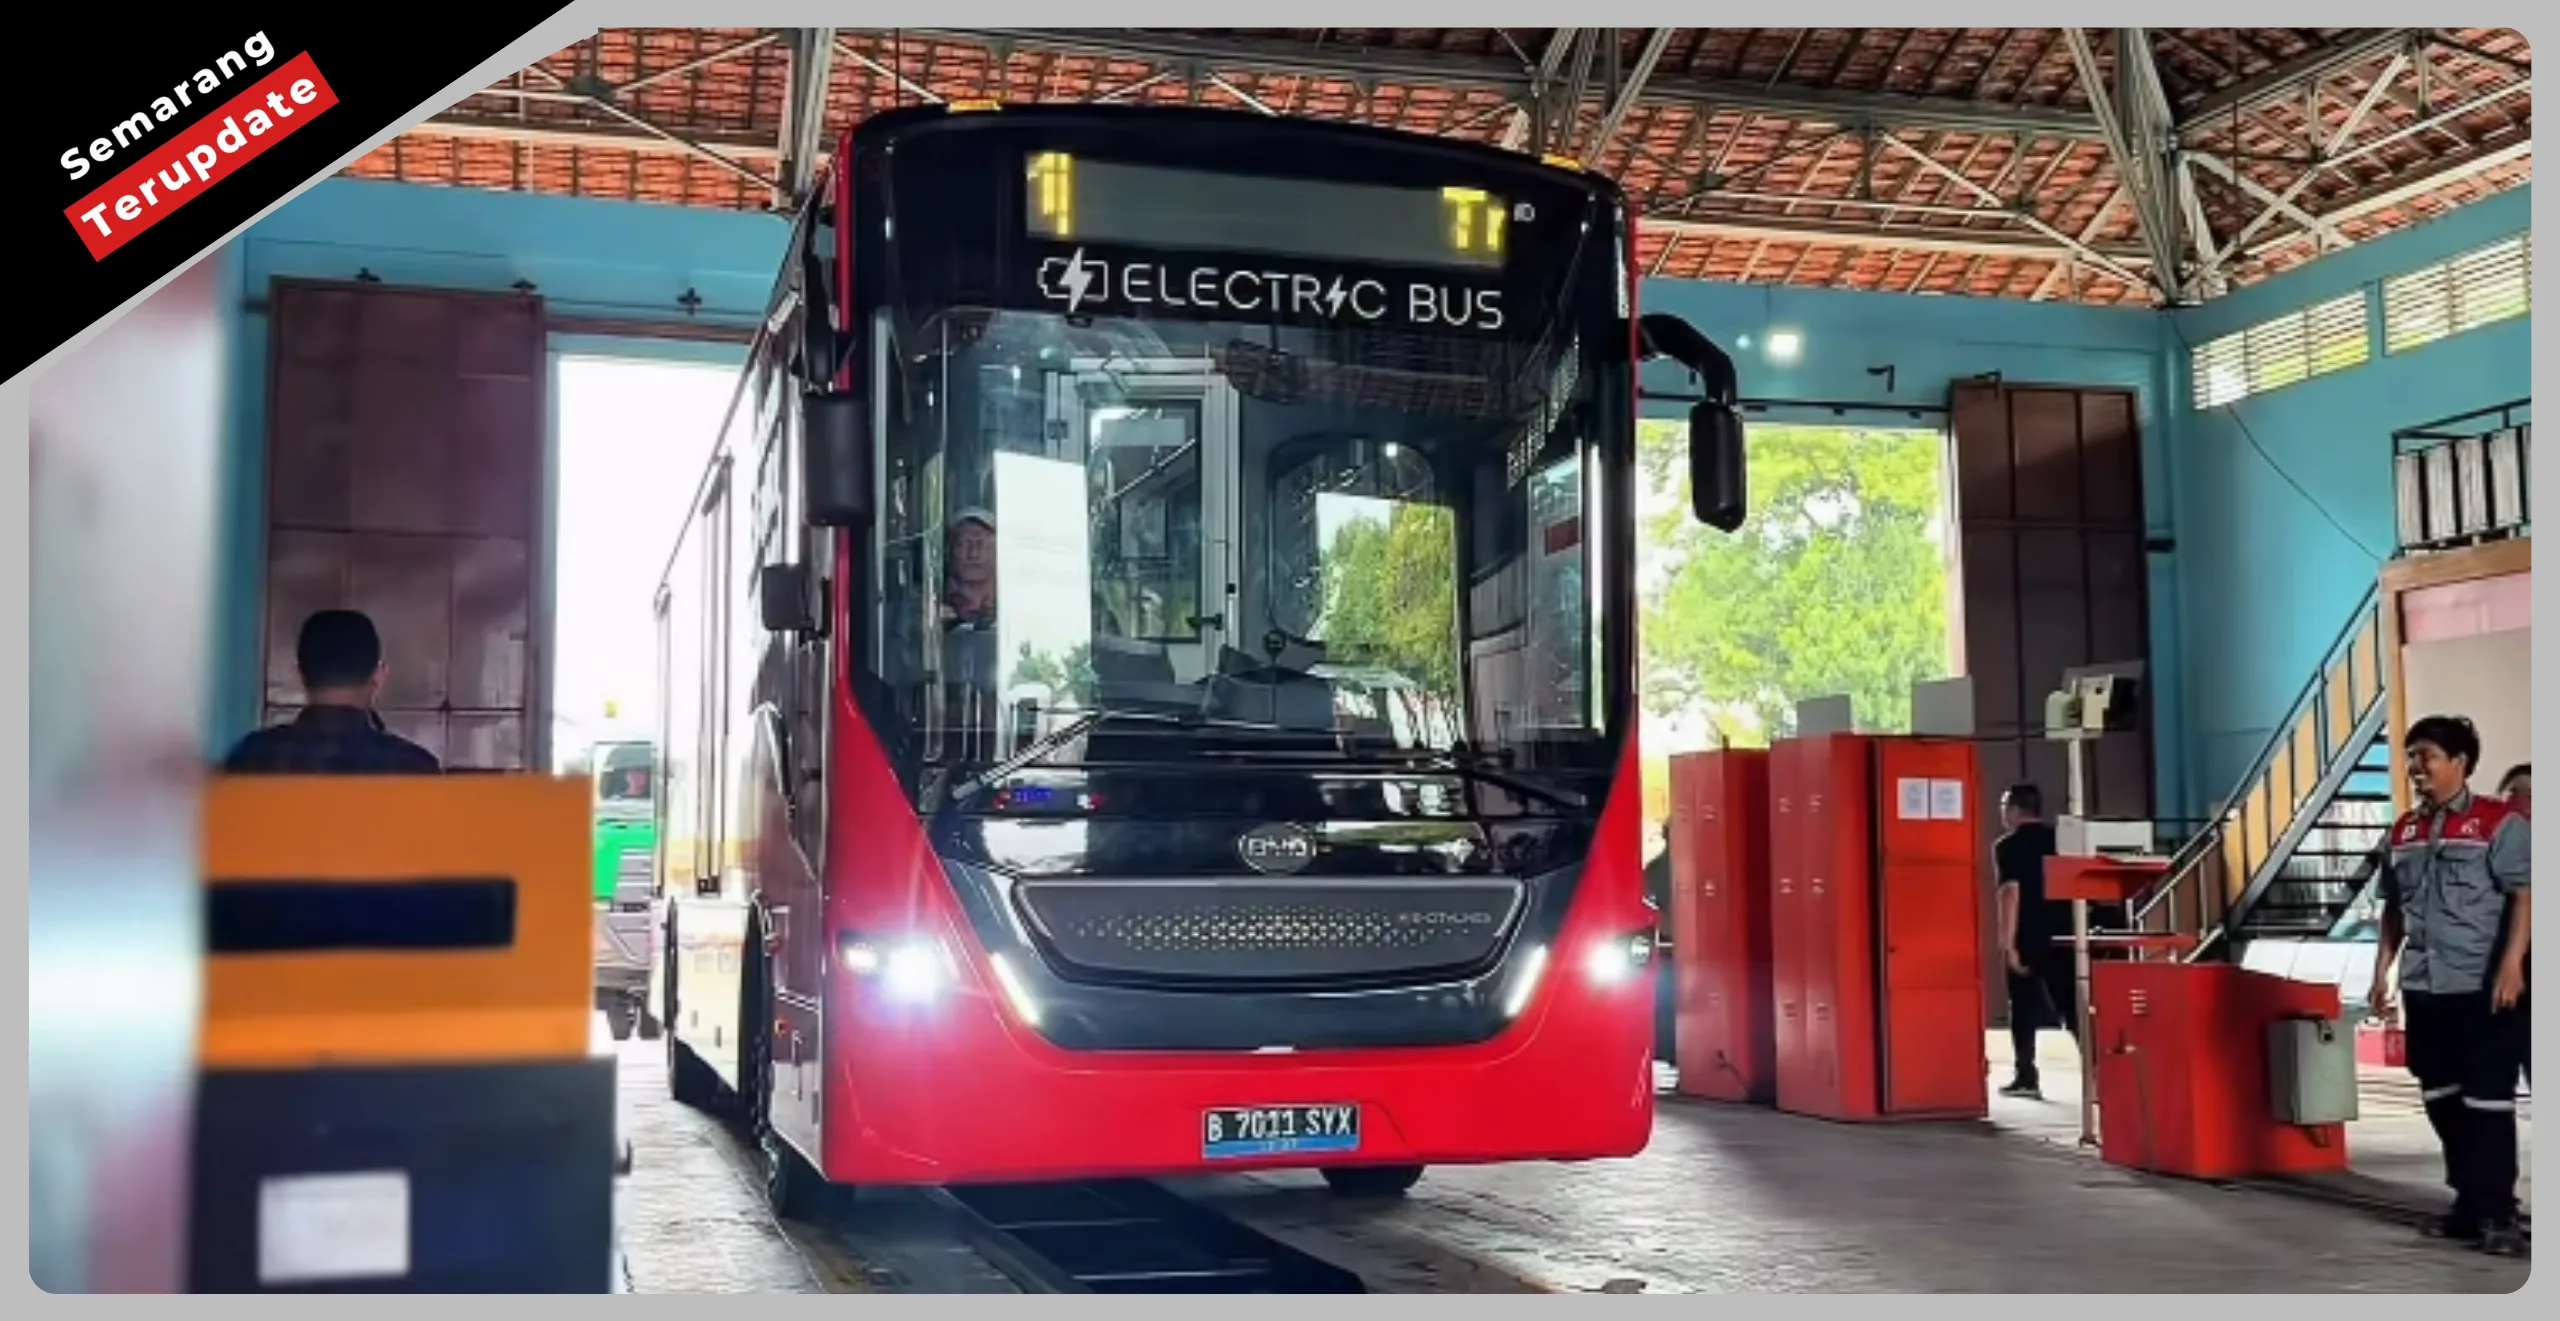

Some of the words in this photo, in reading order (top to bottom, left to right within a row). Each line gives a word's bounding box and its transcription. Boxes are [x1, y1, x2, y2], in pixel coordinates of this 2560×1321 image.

[1408, 283, 1504, 330] BUS
[1207, 1112, 1223, 1142] B
[1305, 1106, 1352, 1136] SYX
